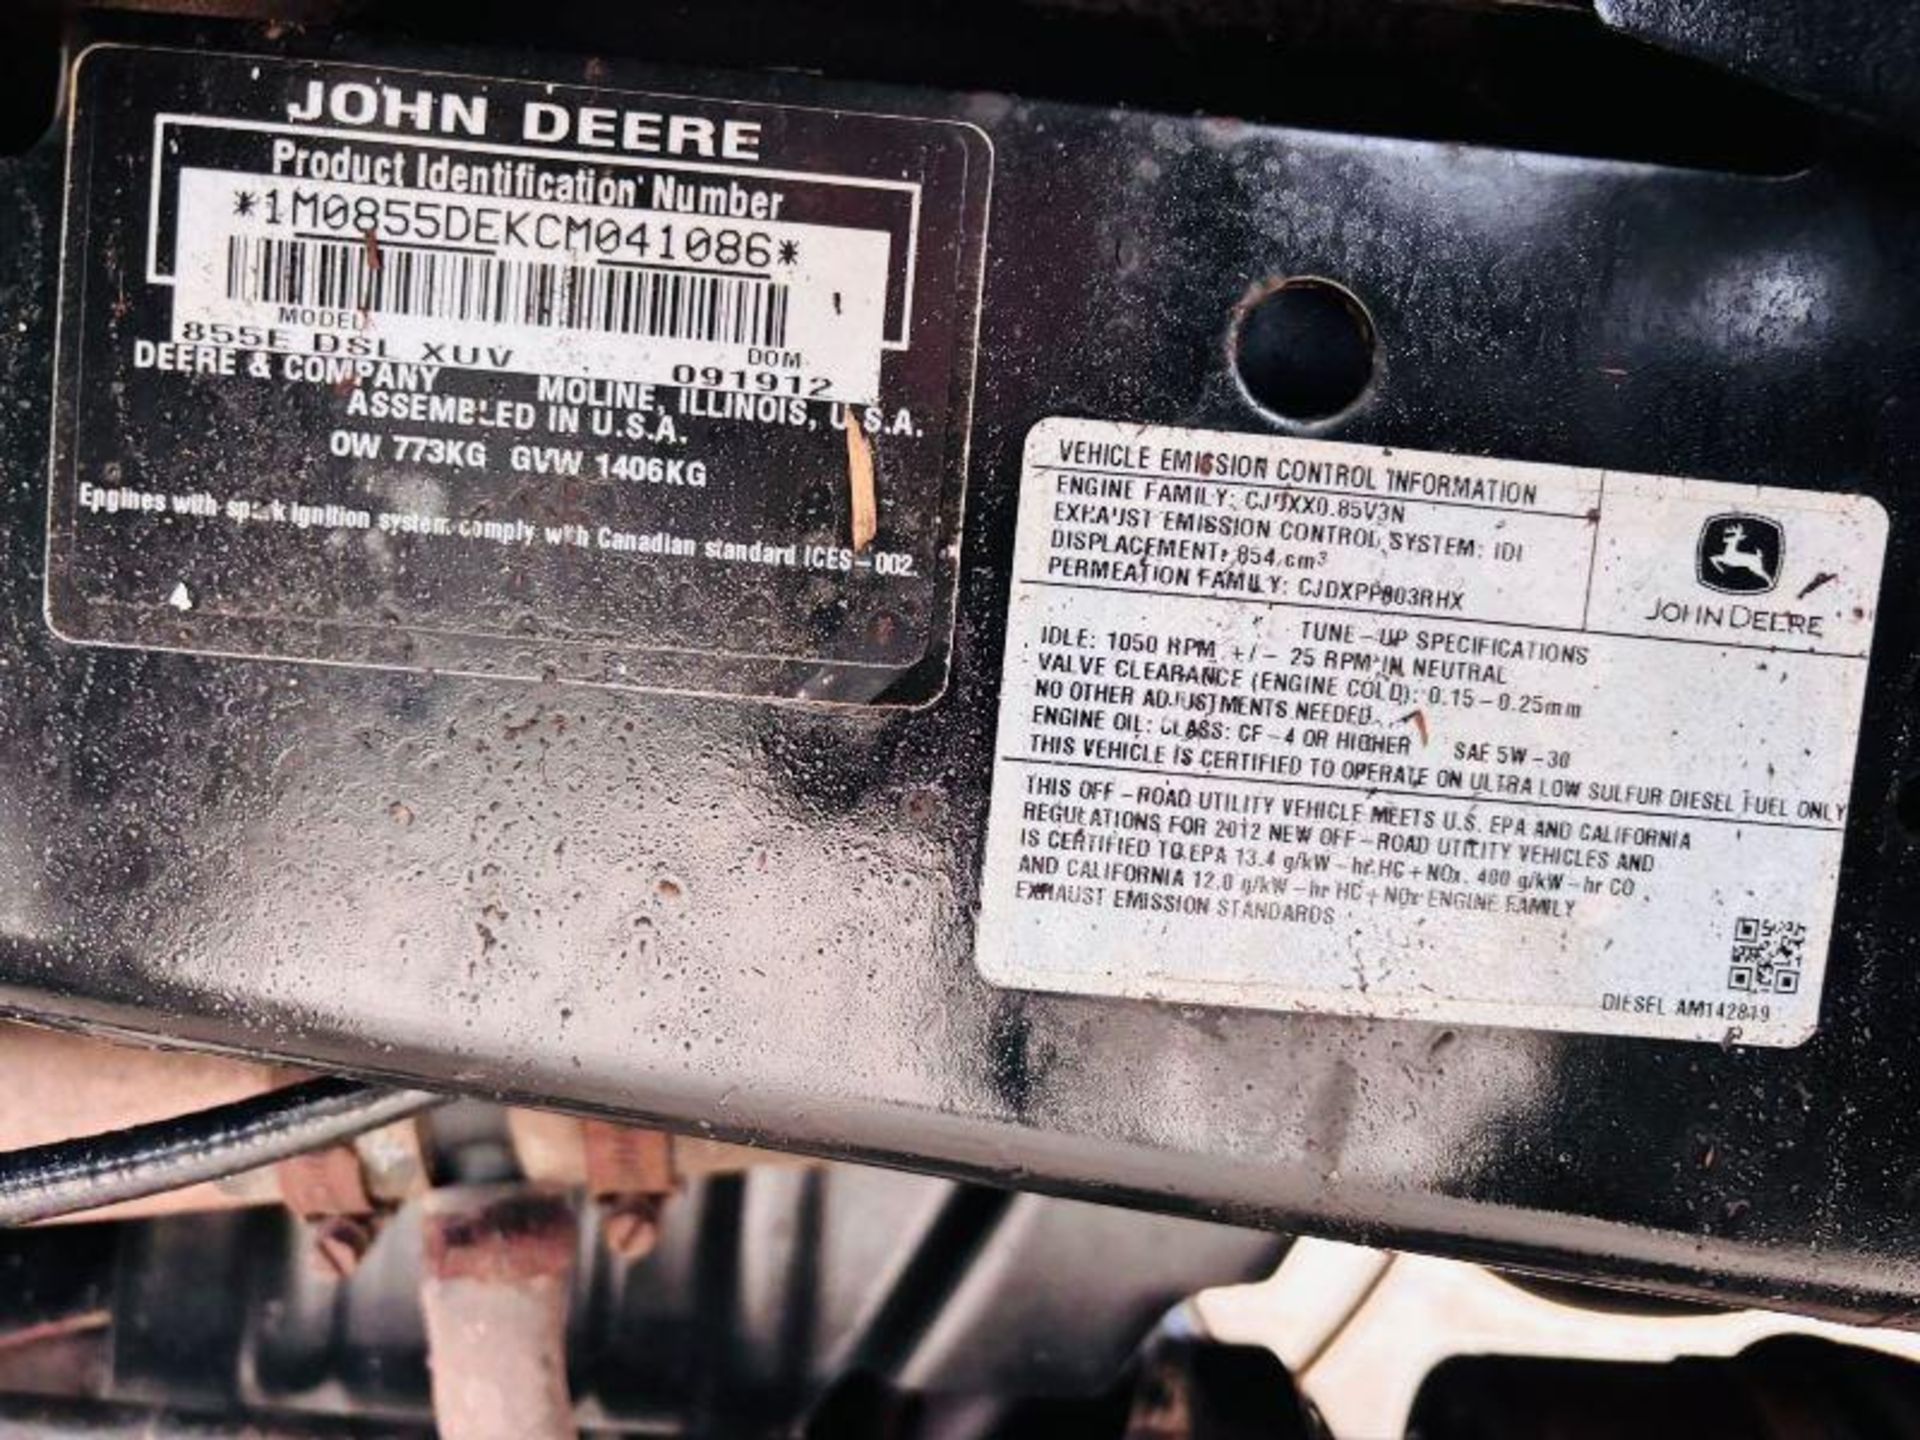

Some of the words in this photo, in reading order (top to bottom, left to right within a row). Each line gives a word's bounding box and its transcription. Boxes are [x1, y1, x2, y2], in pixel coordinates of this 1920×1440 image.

[286, 77, 488, 138] JOHN
[521, 101, 762, 161] DEERE
[270, 137, 407, 188] Product
[415, 151, 638, 209] Identification
[650, 174, 784, 221] Number
[277, 306, 368, 330] MODEL
[132, 339, 237, 376] DEERE
[247, 350, 273, 380] &
[282, 354, 441, 394] COMPANY
[181, 321, 289, 349] 855E
[312, 332, 399, 359] DSL
[420, 341, 514, 369] XUV
[746, 347, 802, 370] DOM
[536, 375, 669, 416] MOLINE,
[676, 388, 820, 431] ILLINOIS,
[671, 363, 834, 397] 091912
[347, 388, 537, 431] ASSEMBLED
[546, 405, 581, 435] IN
[590, 409, 689, 446] U.S.A.
[390, 435, 487, 469] 773KG
[509, 444, 584, 477] GVW
[592, 452, 708, 487] 1406KG
[1055, 472, 1134, 500] ENGINE
[1058, 437, 1151, 470] VEHICLE
[1159, 447, 1269, 481] EMISSION
[1275, 457, 1378, 491] CONTROL
[1384, 468, 1538, 506] INFORMATION
[78, 480, 167, 517] Engines
[171, 490, 218, 517] with
[457, 514, 535, 546] comply
[596, 526, 696, 558] Canadian
[703, 535, 798, 566] standard
[1162, 510, 1271, 541] EMISSION
[1278, 521, 1381, 550] CONTROL
[1387, 531, 1485, 559] SYSTEM:
[1493, 542, 1524, 563] IDI
[1046, 554, 1191, 587] PERMEATION
[1235, 545, 1276, 568] 854
[1645, 596, 1727, 627] JOHN
[1728, 604, 1826, 637] DEERE
[1036, 651, 1107, 676] VALVE
[1114, 657, 1244, 688] CLEARANCE
[1039, 624, 1097, 649] IDLE:
[1105, 630, 1159, 655] 1050
[1166, 635, 1217, 660] RPM
[1289, 646, 1317, 668] 25
[1322, 649, 1372, 672] RPM
[1381, 655, 1406, 675] IN
[1411, 657, 1509, 685] NEUTRAL
[1415, 631, 1591, 666] SPECIFICATIONS
[1034, 677, 1064, 699] NO
[1068, 680, 1135, 705] OTHER
[1031, 704, 1108, 729] ENGINE
[1112, 711, 1152, 733] OIL:
[1301, 728, 1329, 749] OR
[1335, 731, 1412, 756] HIGHER
[1453, 741, 1490, 762] SAE
[1028, 733, 1077, 755] THIS
[1082, 738, 1166, 764] VEHICLE
[1172, 744, 1194, 766] IS
[1199, 748, 1303, 775] CERTIFIED
[1310, 757, 1335, 778] TO
[1340, 760, 1430, 787] OPERATE
[1436, 769, 1463, 789] ON
[1468, 771, 1533, 794] ULTRA
[1539, 777, 1583, 799] LOW
[1587, 780, 1662, 807] SULFUR
[1669, 788, 1735, 812] DIESEL
[1739, 791, 1790, 816] FUEL
[1796, 799, 1848, 822] ONLY
[1022, 802, 1161, 832] REGULATIONS
[1167, 815, 1207, 836] FOR
[1213, 818, 1261, 841] 2012
[1267, 823, 1312, 845] NEW
[1436, 837, 1512, 862] UTILITY
[1517, 844, 1609, 869] VEHICLES
[1615, 852, 1655, 873] AND
[1024, 775, 1072, 798] THIS
[1197, 790, 1275, 815] UTILITY
[1281, 798, 1362, 823] VEHICLE
[1369, 805, 1435, 829] MEETS
[1441, 811, 1484, 833] U.S.
[1488, 815, 1527, 836] EPA
[1533, 818, 1572, 840] AND
[1578, 823, 1693, 850] CALIFORNIA
[1016, 854, 1059, 876] AND
[1065, 858, 1185, 887] CALIFORNIA
[1019, 828, 1040, 848] IS
[1047, 831, 1151, 857] CERTIFIED
[1188, 843, 1228, 864] EPA
[1235, 847, 1276, 868] 13.4
[1608, 878, 1636, 897] CO
[1111, 888, 1211, 915] EMISSION
[1215, 898, 1337, 925] STANDARDS
[1599, 991, 1668, 1016] DIESEL
